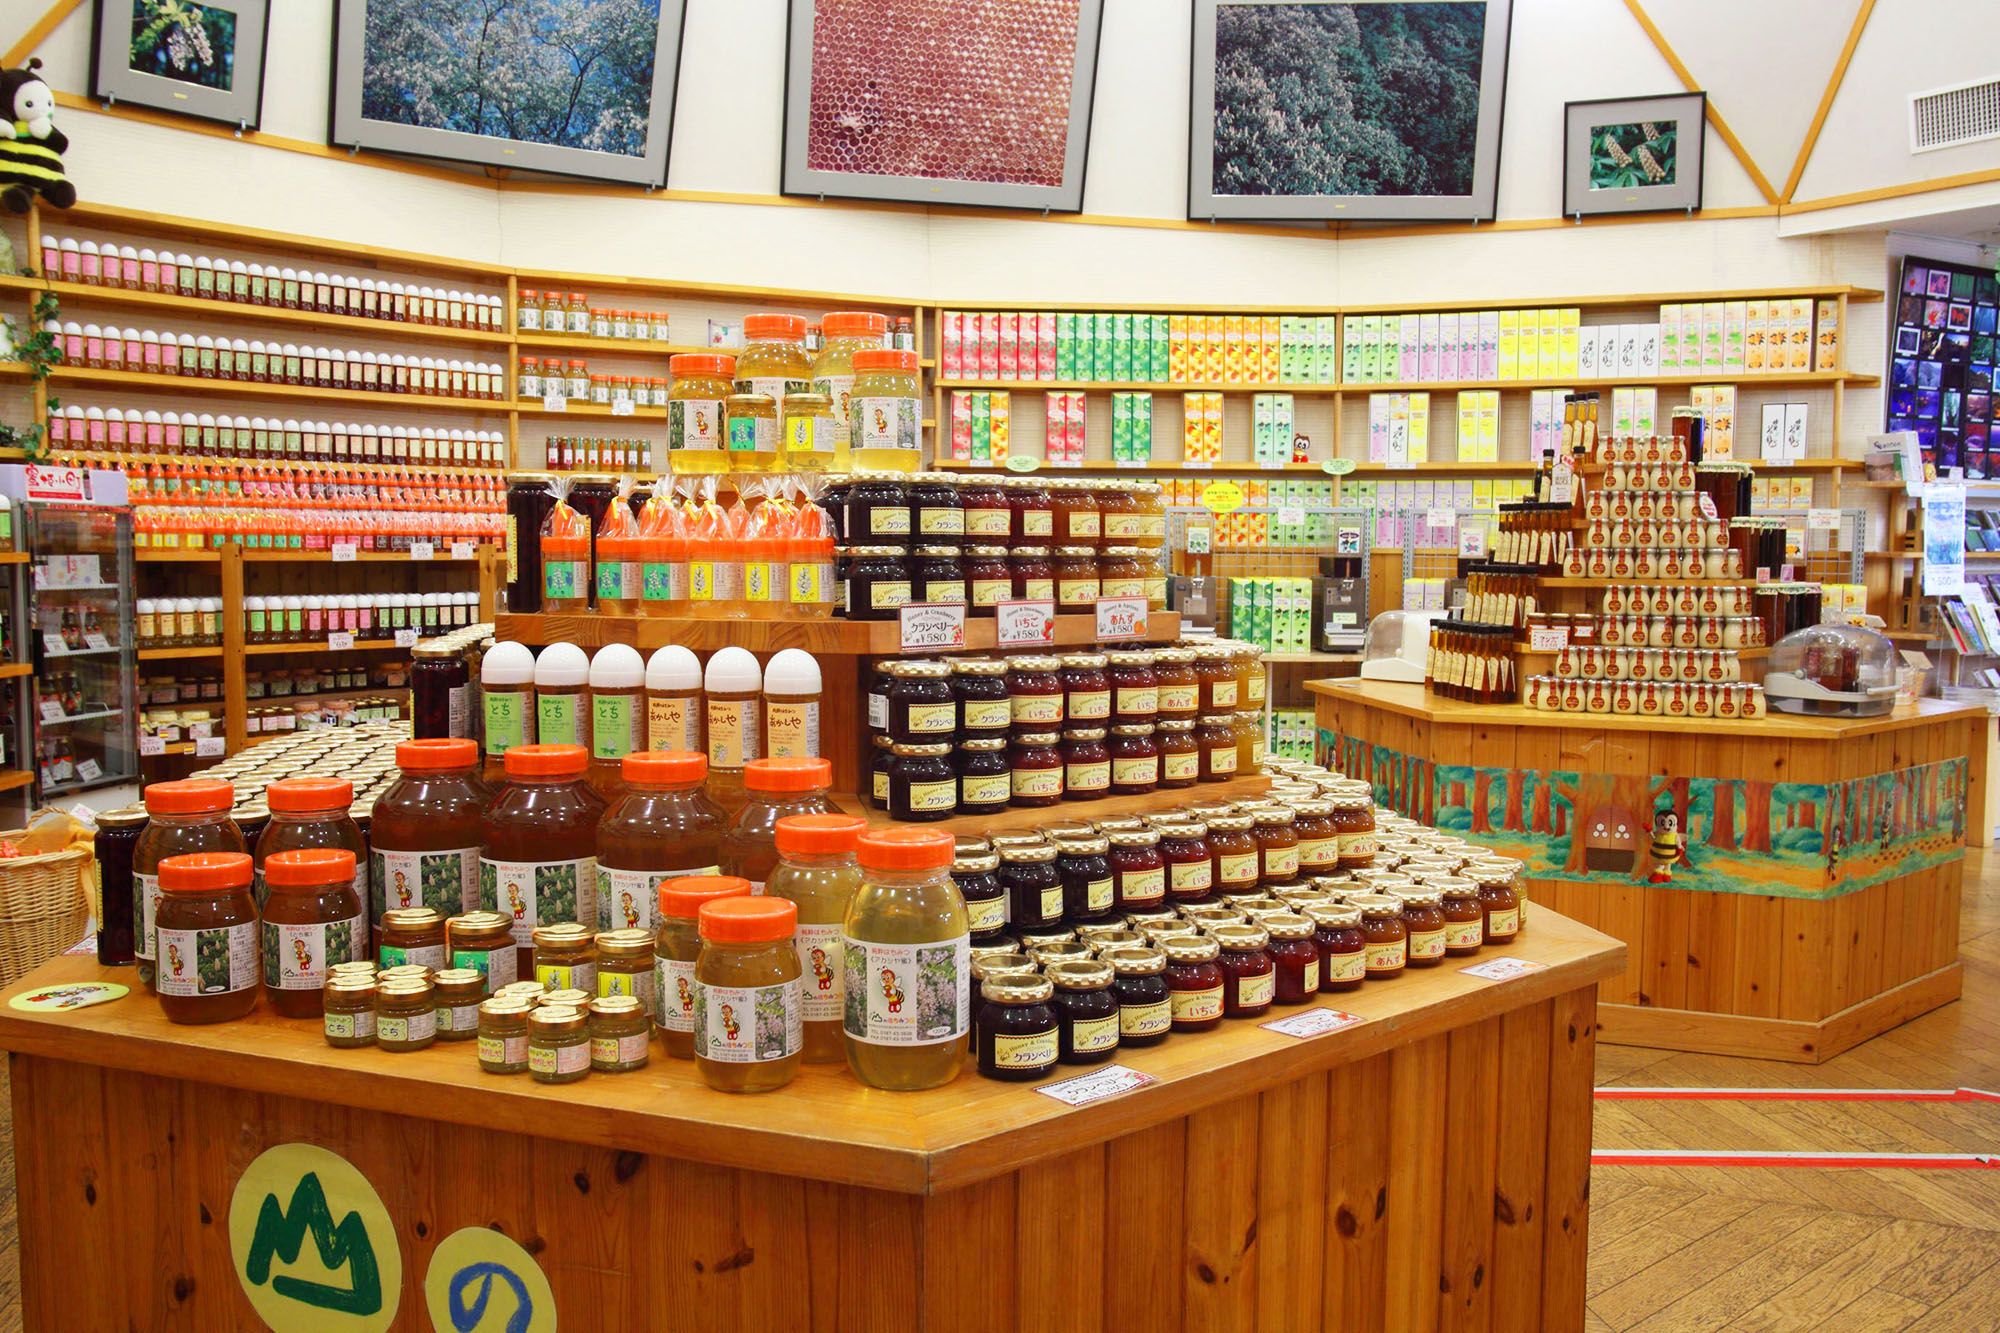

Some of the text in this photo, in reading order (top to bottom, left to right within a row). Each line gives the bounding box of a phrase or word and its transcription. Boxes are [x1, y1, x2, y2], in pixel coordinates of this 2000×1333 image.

[1014, 617, 1039, 627] いちご
[1111, 613, 1135, 625] あんず
[911, 622, 953, 633] クランベリー
[1112, 625, 1133, 634] ¥580
[920, 633, 947, 643] ¥580
[1017, 629, 1039, 639] ¥580
[1167, 698, 1191, 707] あんず
[491, 703, 510, 715] とち
[543, 705, 562, 718] とち
[599, 706, 618, 719] とち
[1028, 710, 1055, 718] いちご
[650, 708, 680, 723] あかしや
[709, 712, 737, 726] あかしや
[769, 714, 802, 729] あかしや
[1133, 771, 1154, 780] いちご
[1031, 783, 1056, 792] いちご
[1375, 953, 1401, 967] あんず
[1189, 1006, 1218, 1017] いちご
